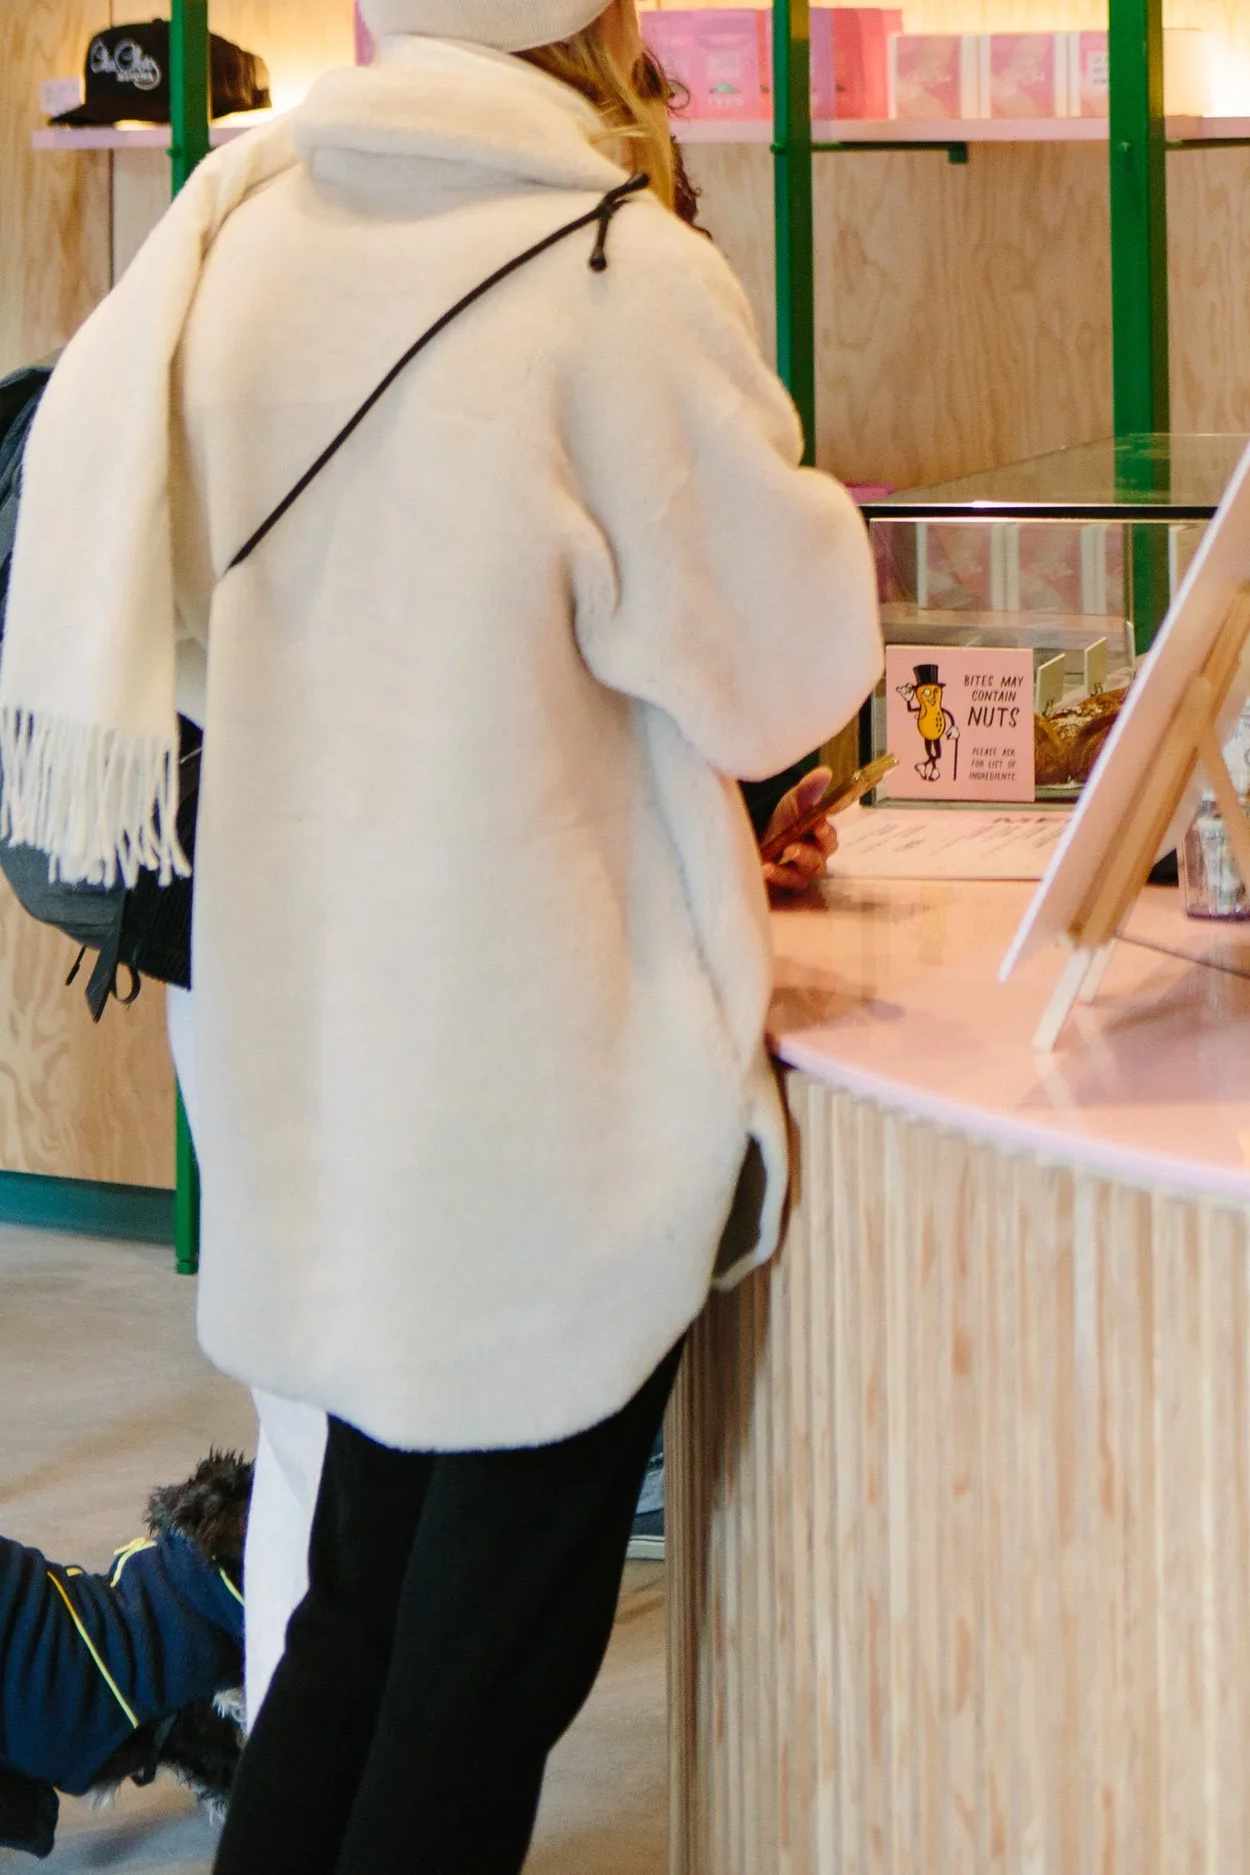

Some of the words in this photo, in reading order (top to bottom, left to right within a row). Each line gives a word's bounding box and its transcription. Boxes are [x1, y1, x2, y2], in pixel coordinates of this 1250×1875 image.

[964, 674, 994, 687] BITES
[1001, 675, 1024, 688] MAY
[971, 690, 1017, 702] CONTAIN
[968, 706, 1020, 728] NUTS
[972, 746, 997, 756] PLEASE
[1001, 747, 1016, 756] ASK
[971, 758, 985, 768] FOR
[988, 758, 1003, 768] LIST
[1007, 759, 1016, 768] OF
[968, 771, 1016, 781] INGREDIENTS
